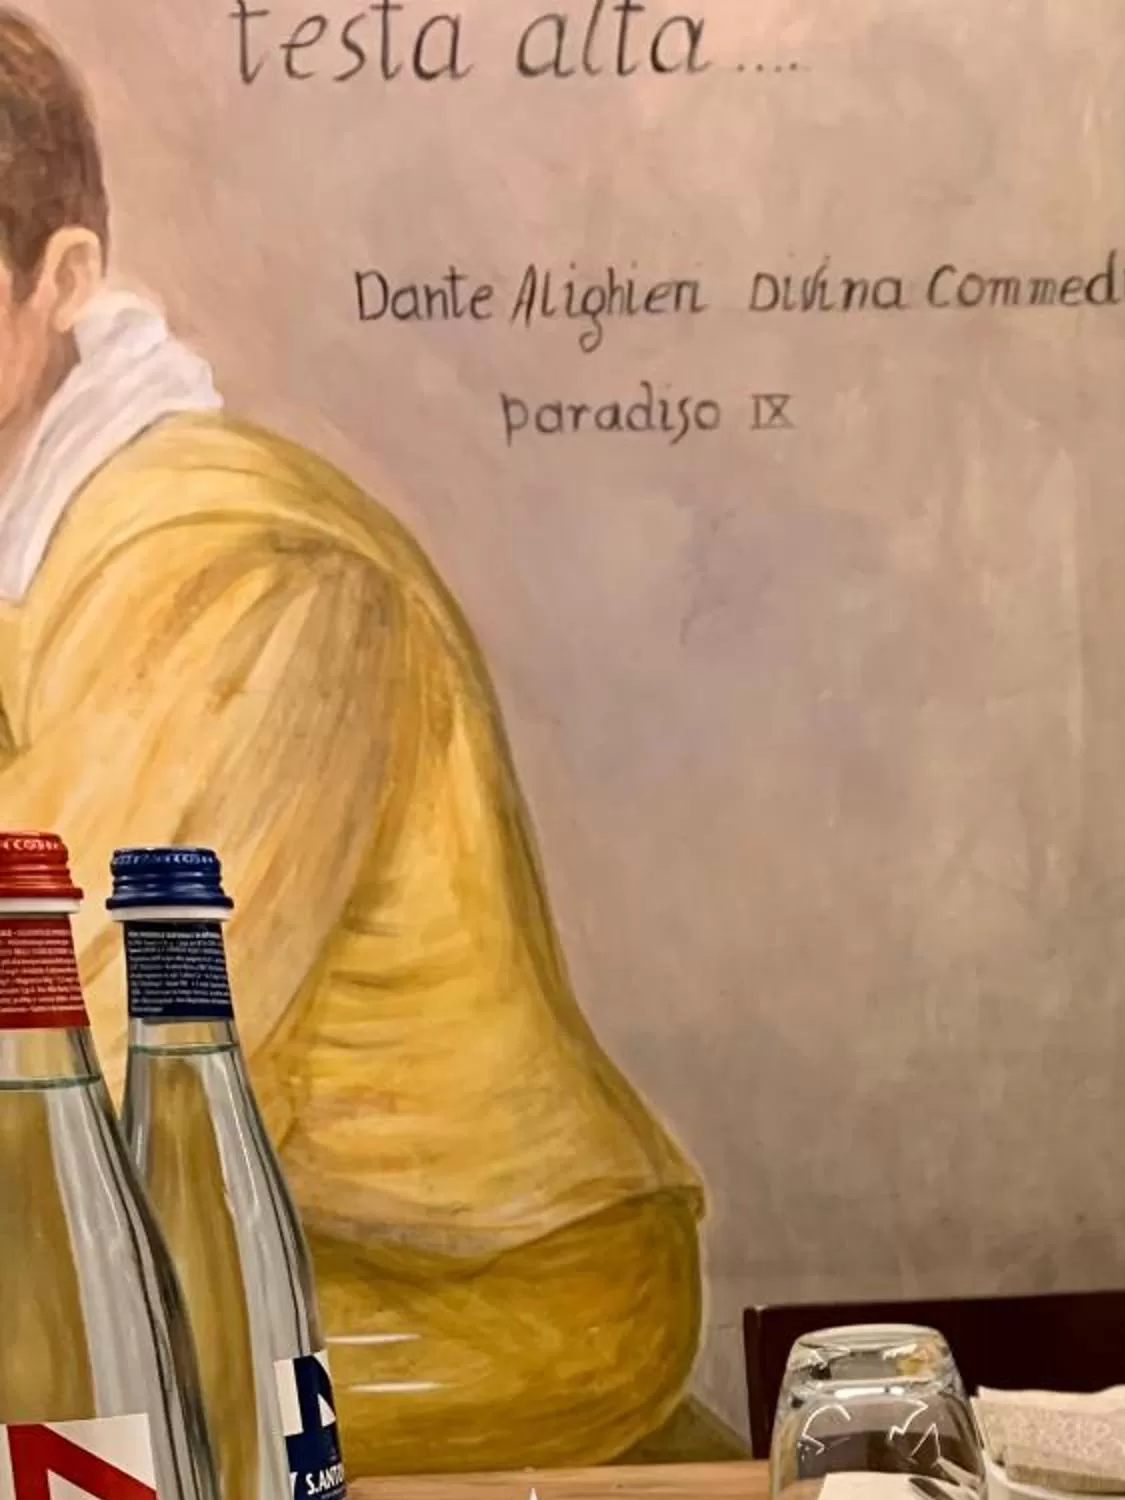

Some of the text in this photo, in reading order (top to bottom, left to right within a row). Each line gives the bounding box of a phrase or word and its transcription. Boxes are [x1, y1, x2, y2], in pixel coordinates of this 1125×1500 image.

[228, 0, 474, 85] testa
[354, 264, 496, 322] Dante
[500, 380, 795, 447] paradiso IX
